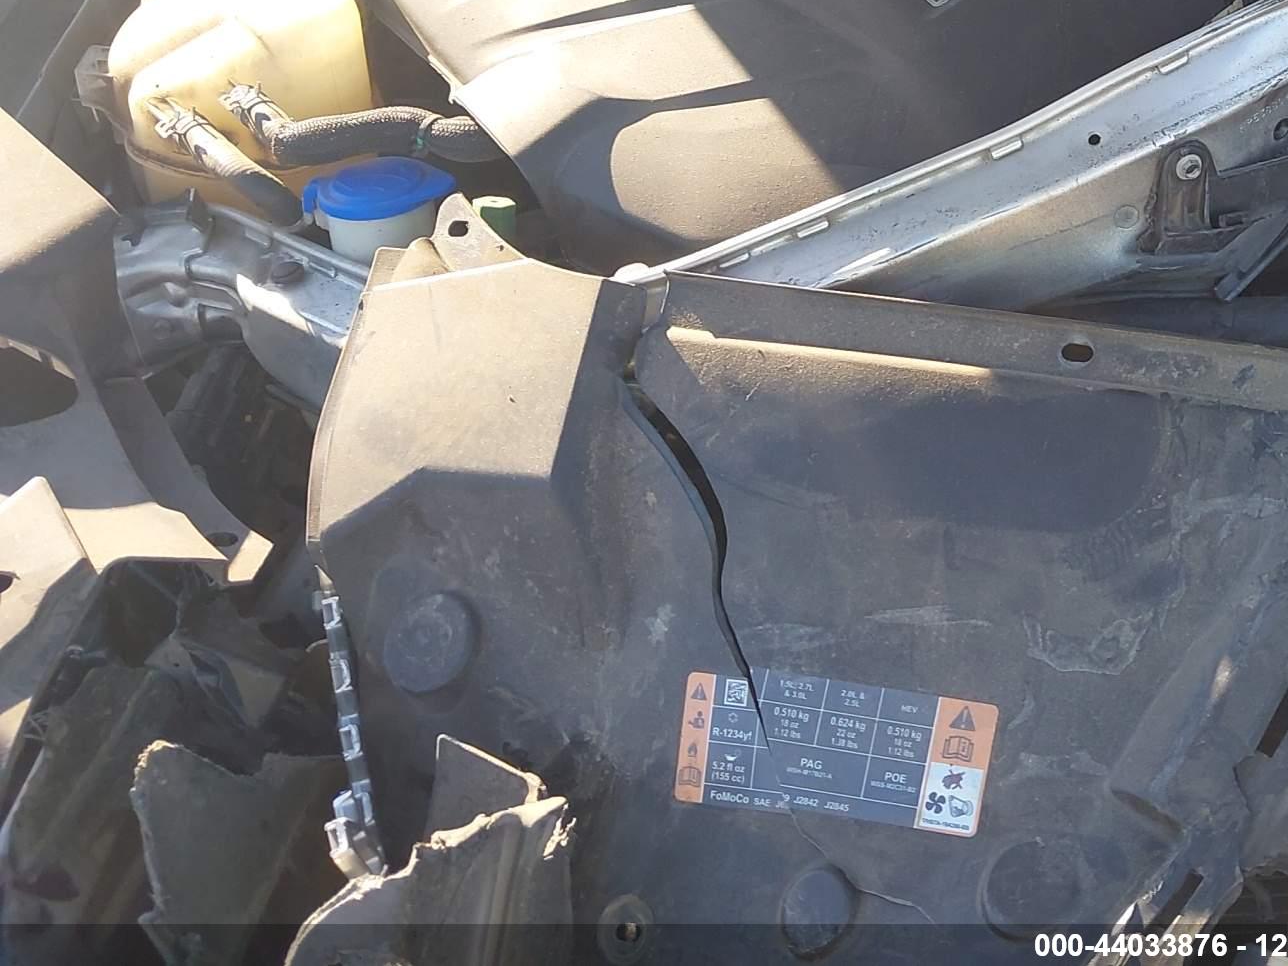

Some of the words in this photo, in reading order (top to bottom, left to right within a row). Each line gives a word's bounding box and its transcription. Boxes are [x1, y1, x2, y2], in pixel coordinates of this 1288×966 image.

[773, 706, 798, 719] 0.510
[798, 708, 810, 722] kg
[830, 716, 854, 728] 0.624
[855, 719, 866, 732] kg
[712, 727, 753, 742] R-1234yf
[886, 726, 910, 738] 0.510
[911, 729, 922, 742] kg
[712, 761, 725, 771] 5.2
[734, 765, 745, 774] oz
[800, 757, 823, 771] PAG
[711, 770, 730, 782] (155
[731, 773, 745, 785] cc)
[884, 771, 908, 784] POE
[710, 790, 750, 804] FoMoCo
[753, 797, 771, 807] SAE
